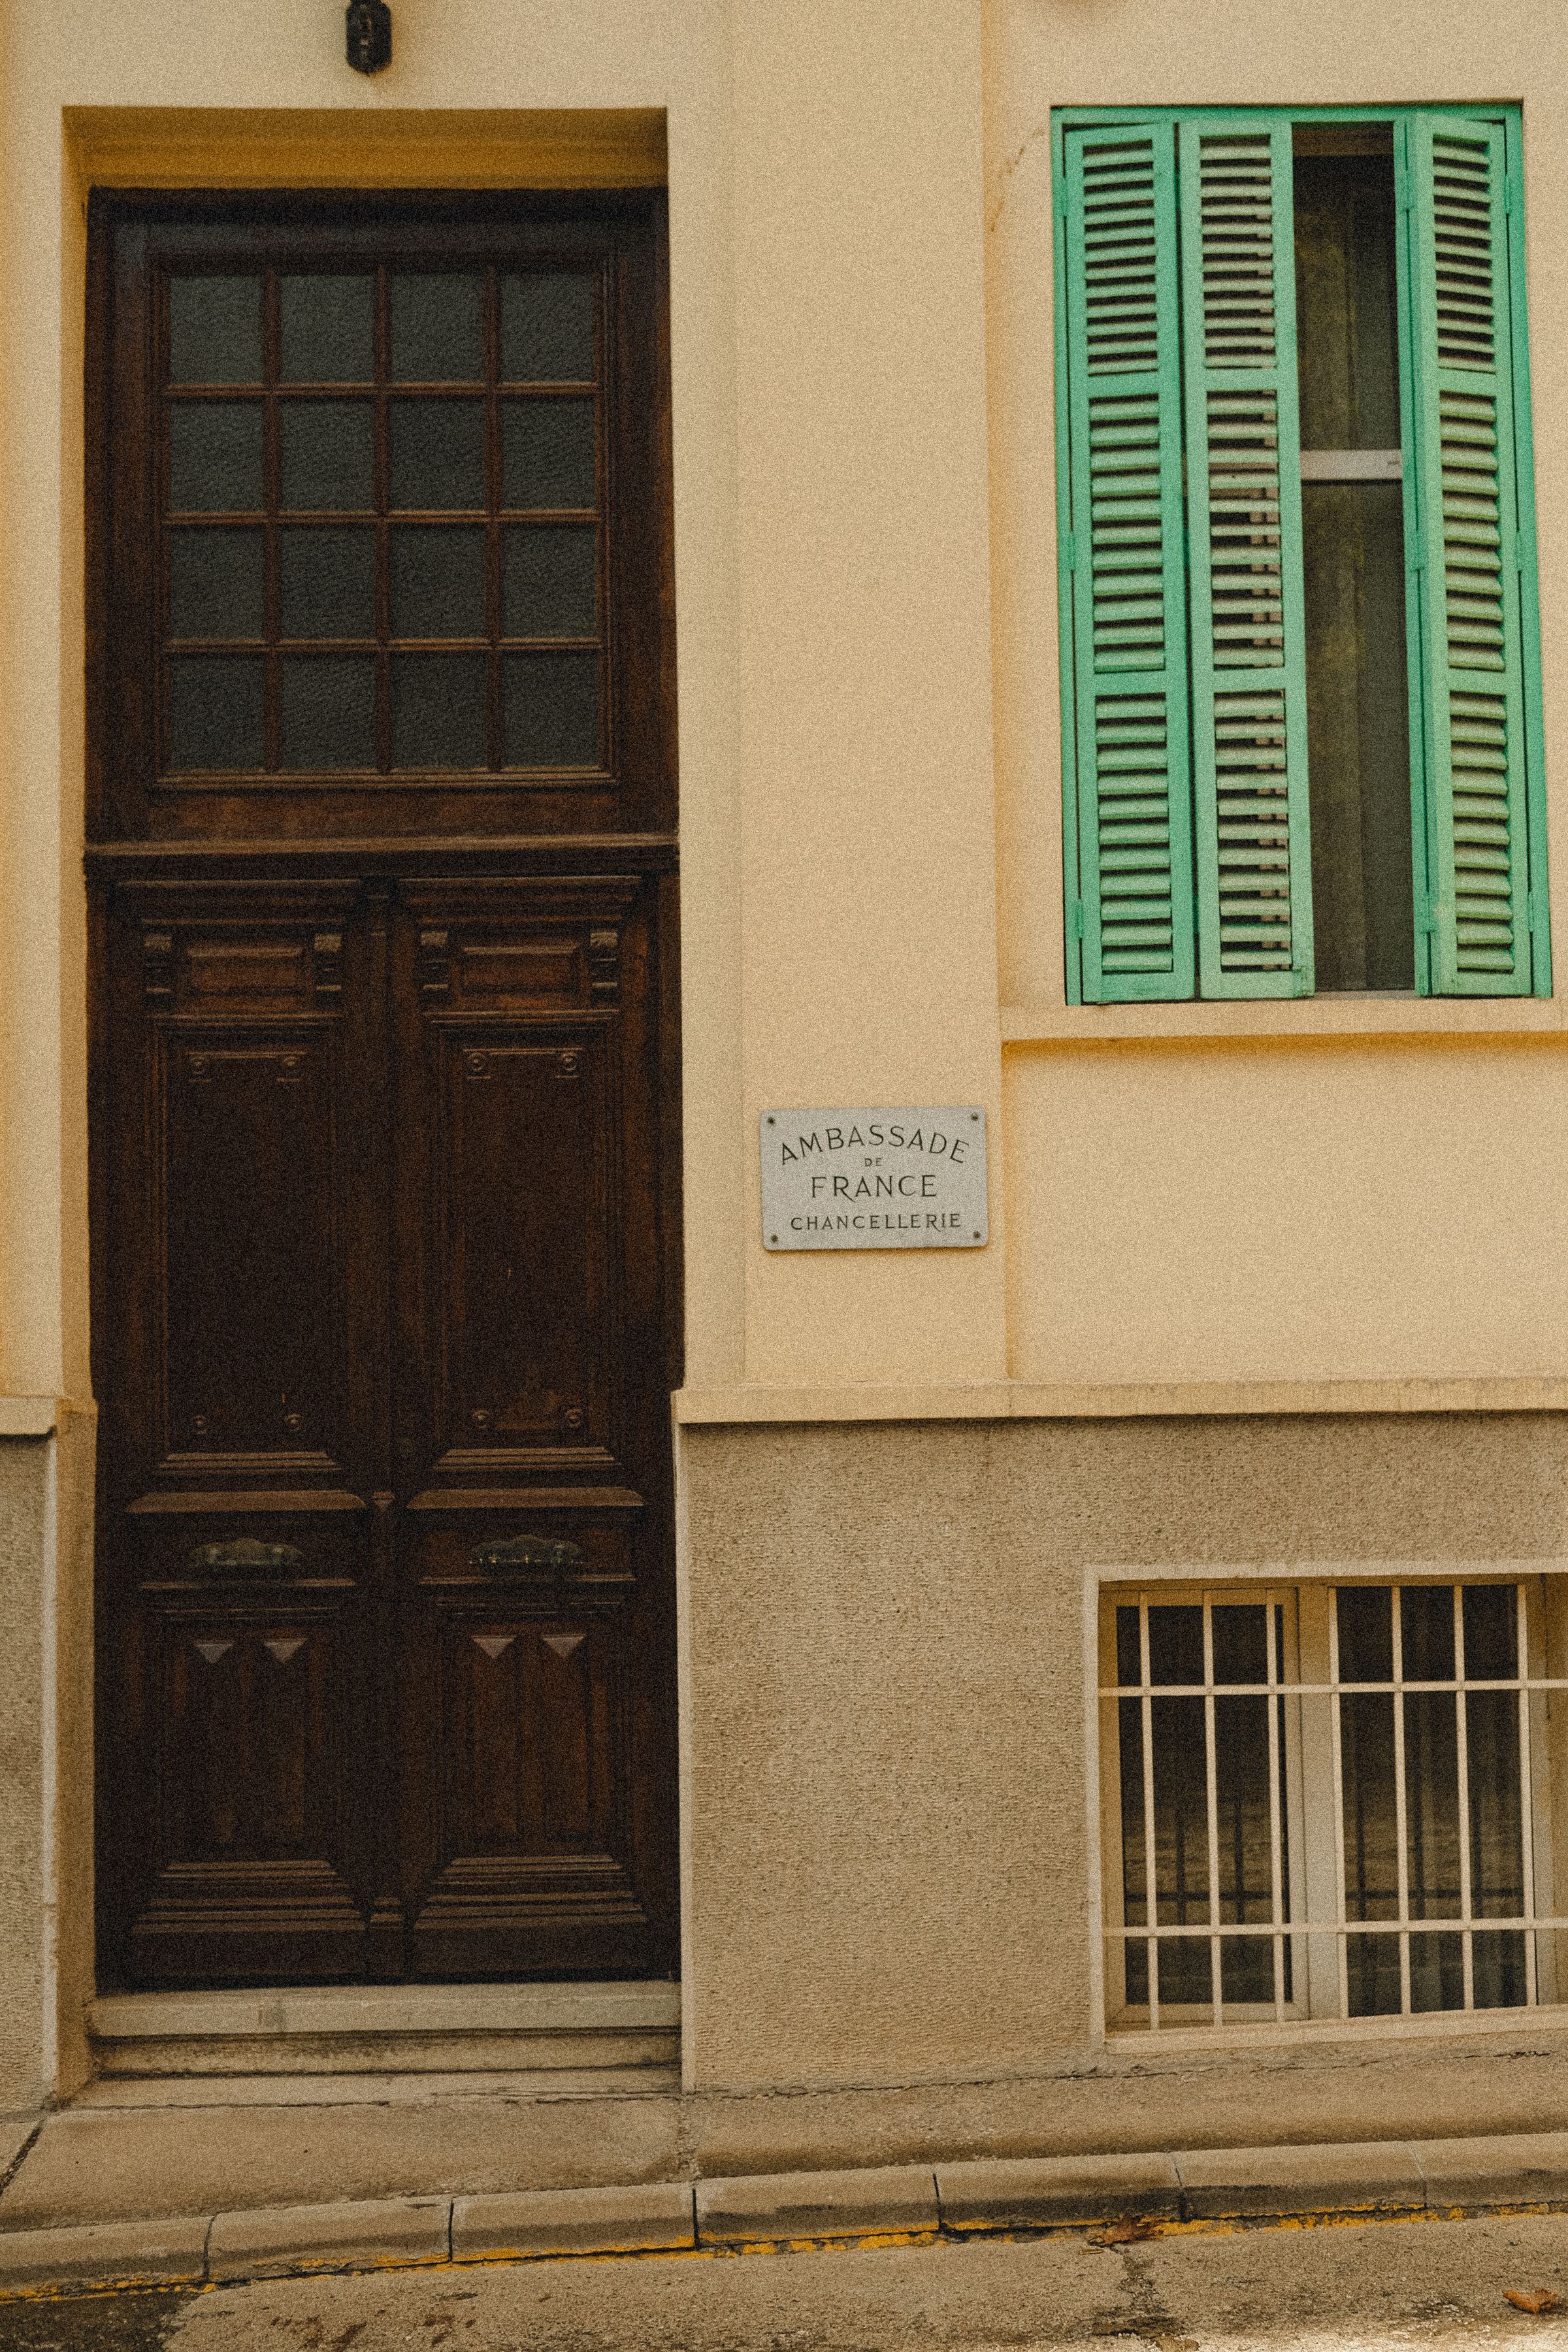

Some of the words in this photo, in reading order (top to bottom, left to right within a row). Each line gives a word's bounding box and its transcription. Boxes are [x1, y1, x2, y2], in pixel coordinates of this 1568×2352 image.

[782, 1124, 970, 1166] AMBASSADE
[864, 1158, 882, 1167] DE
[811, 1175, 938, 1202] FRANCE
[791, 1213, 962, 1232] CHANCELLERIE
